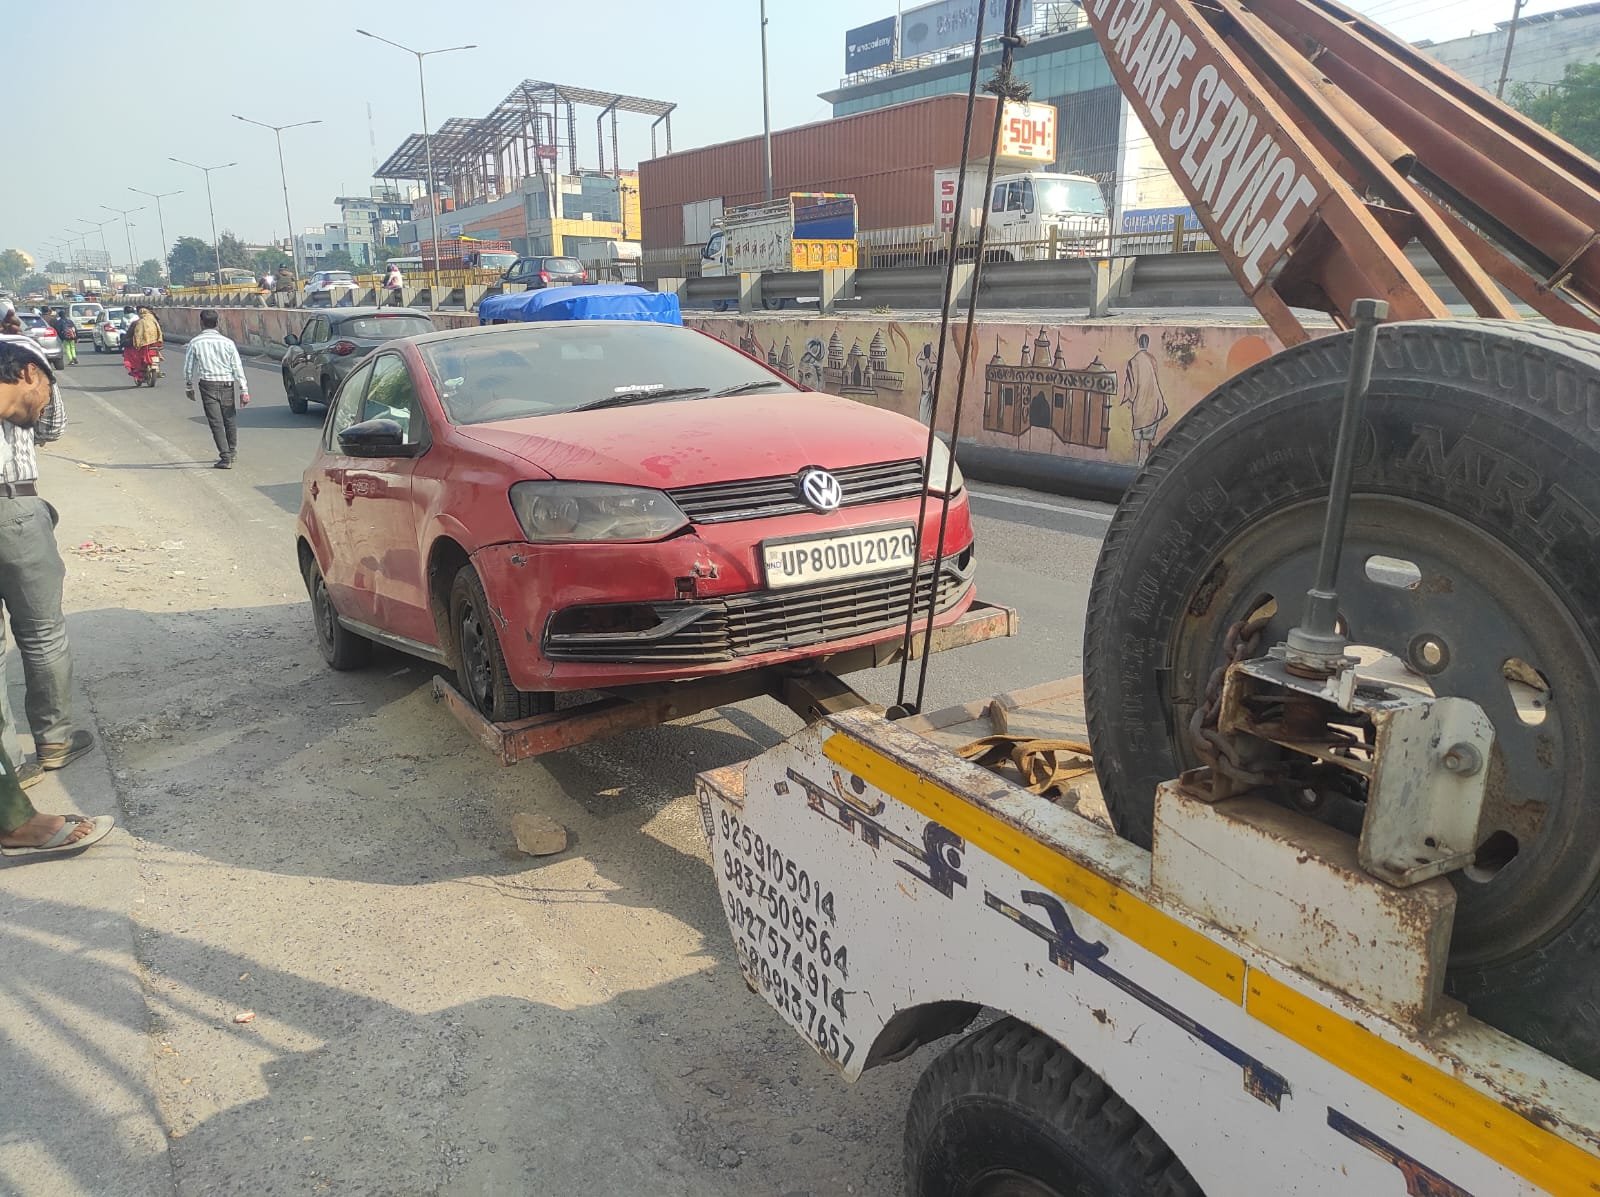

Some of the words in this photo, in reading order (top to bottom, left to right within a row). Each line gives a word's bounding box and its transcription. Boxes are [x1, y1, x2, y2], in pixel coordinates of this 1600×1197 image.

[1010, 117, 1046, 146] SDH
[1169, 65, 1318, 288] SERVICE
[1396, 423, 1600, 543] MRF
[781, 533, 913, 576] UP80DU2020
[721, 809, 837, 928] 9259105014
[724, 849, 849, 981] 9837509564
[728, 890, 848, 1026] 9027574914
